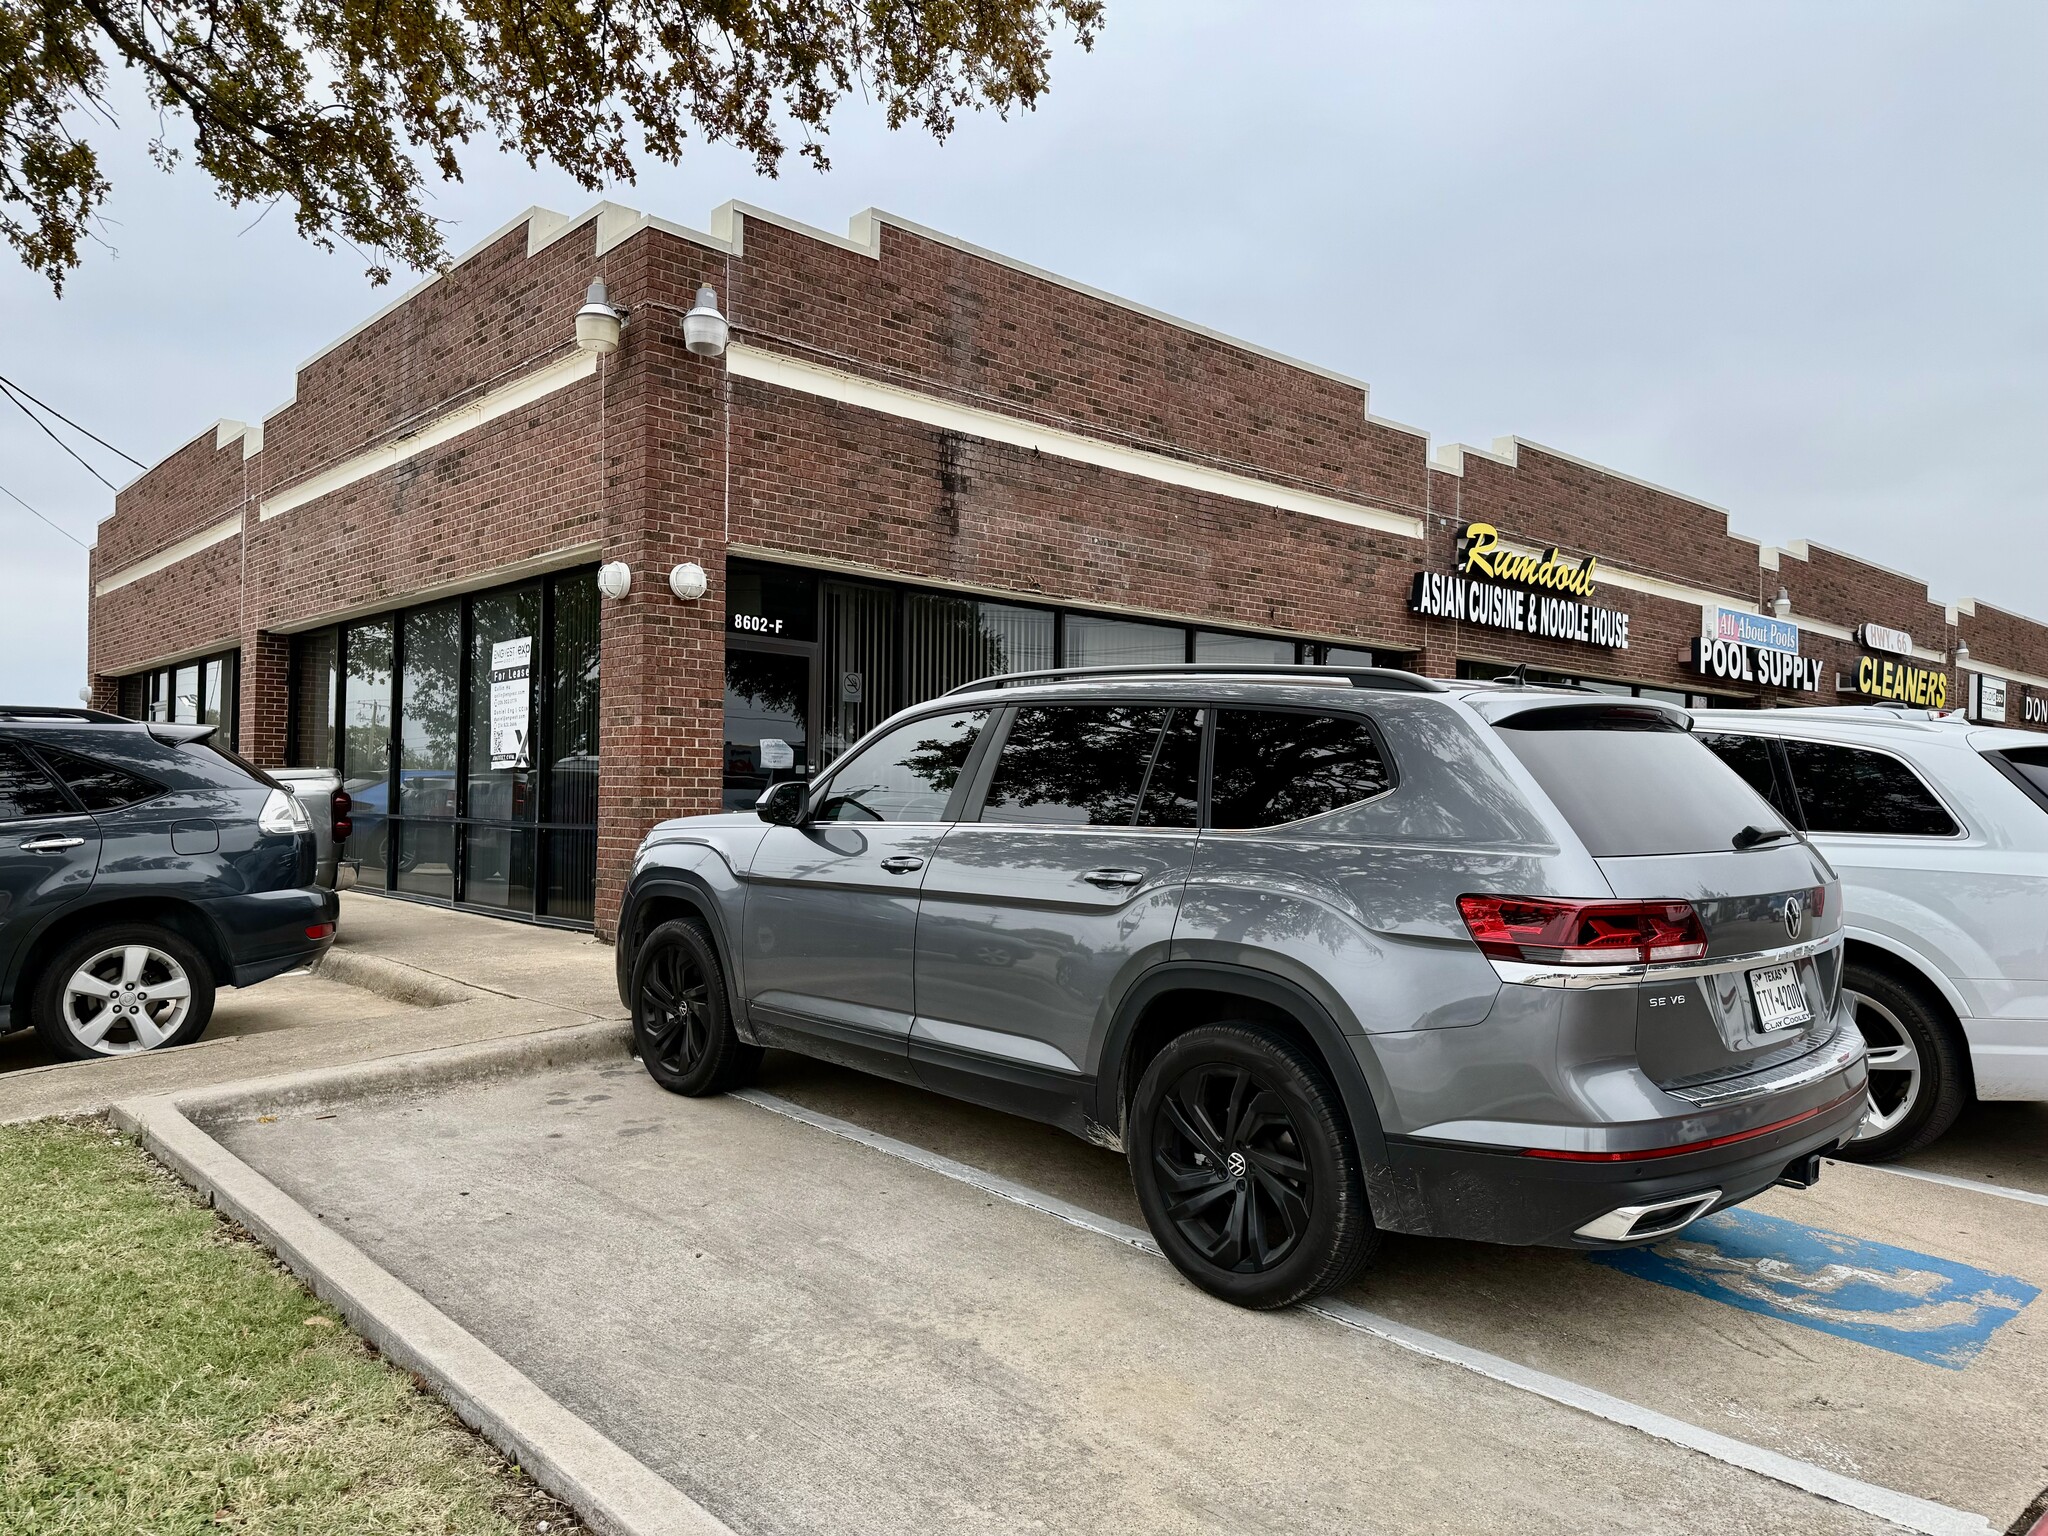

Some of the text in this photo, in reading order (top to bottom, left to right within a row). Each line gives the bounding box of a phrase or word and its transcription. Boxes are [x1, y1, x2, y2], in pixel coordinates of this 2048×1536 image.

[1465, 522, 1596, 597] Rumdoul
[1420, 571, 1629, 649] ASIAN CUISINE & NOODLE HOUSE
[734, 613, 783, 634] 8602-F
[1719, 612, 1796, 649] All About Pools
[1896, 633, 1907, 653] 66
[493, 667, 530, 682] For Lease
[1700, 636, 1824, 692] POOL SUPPLY
[1859, 655, 1947, 709] CLEANERS
[1763, 969, 1783, 983] TEXAS
[1649, 995, 1686, 1007] SE V6
[1763, 1013, 1811, 1032] CLAY COOLEY
